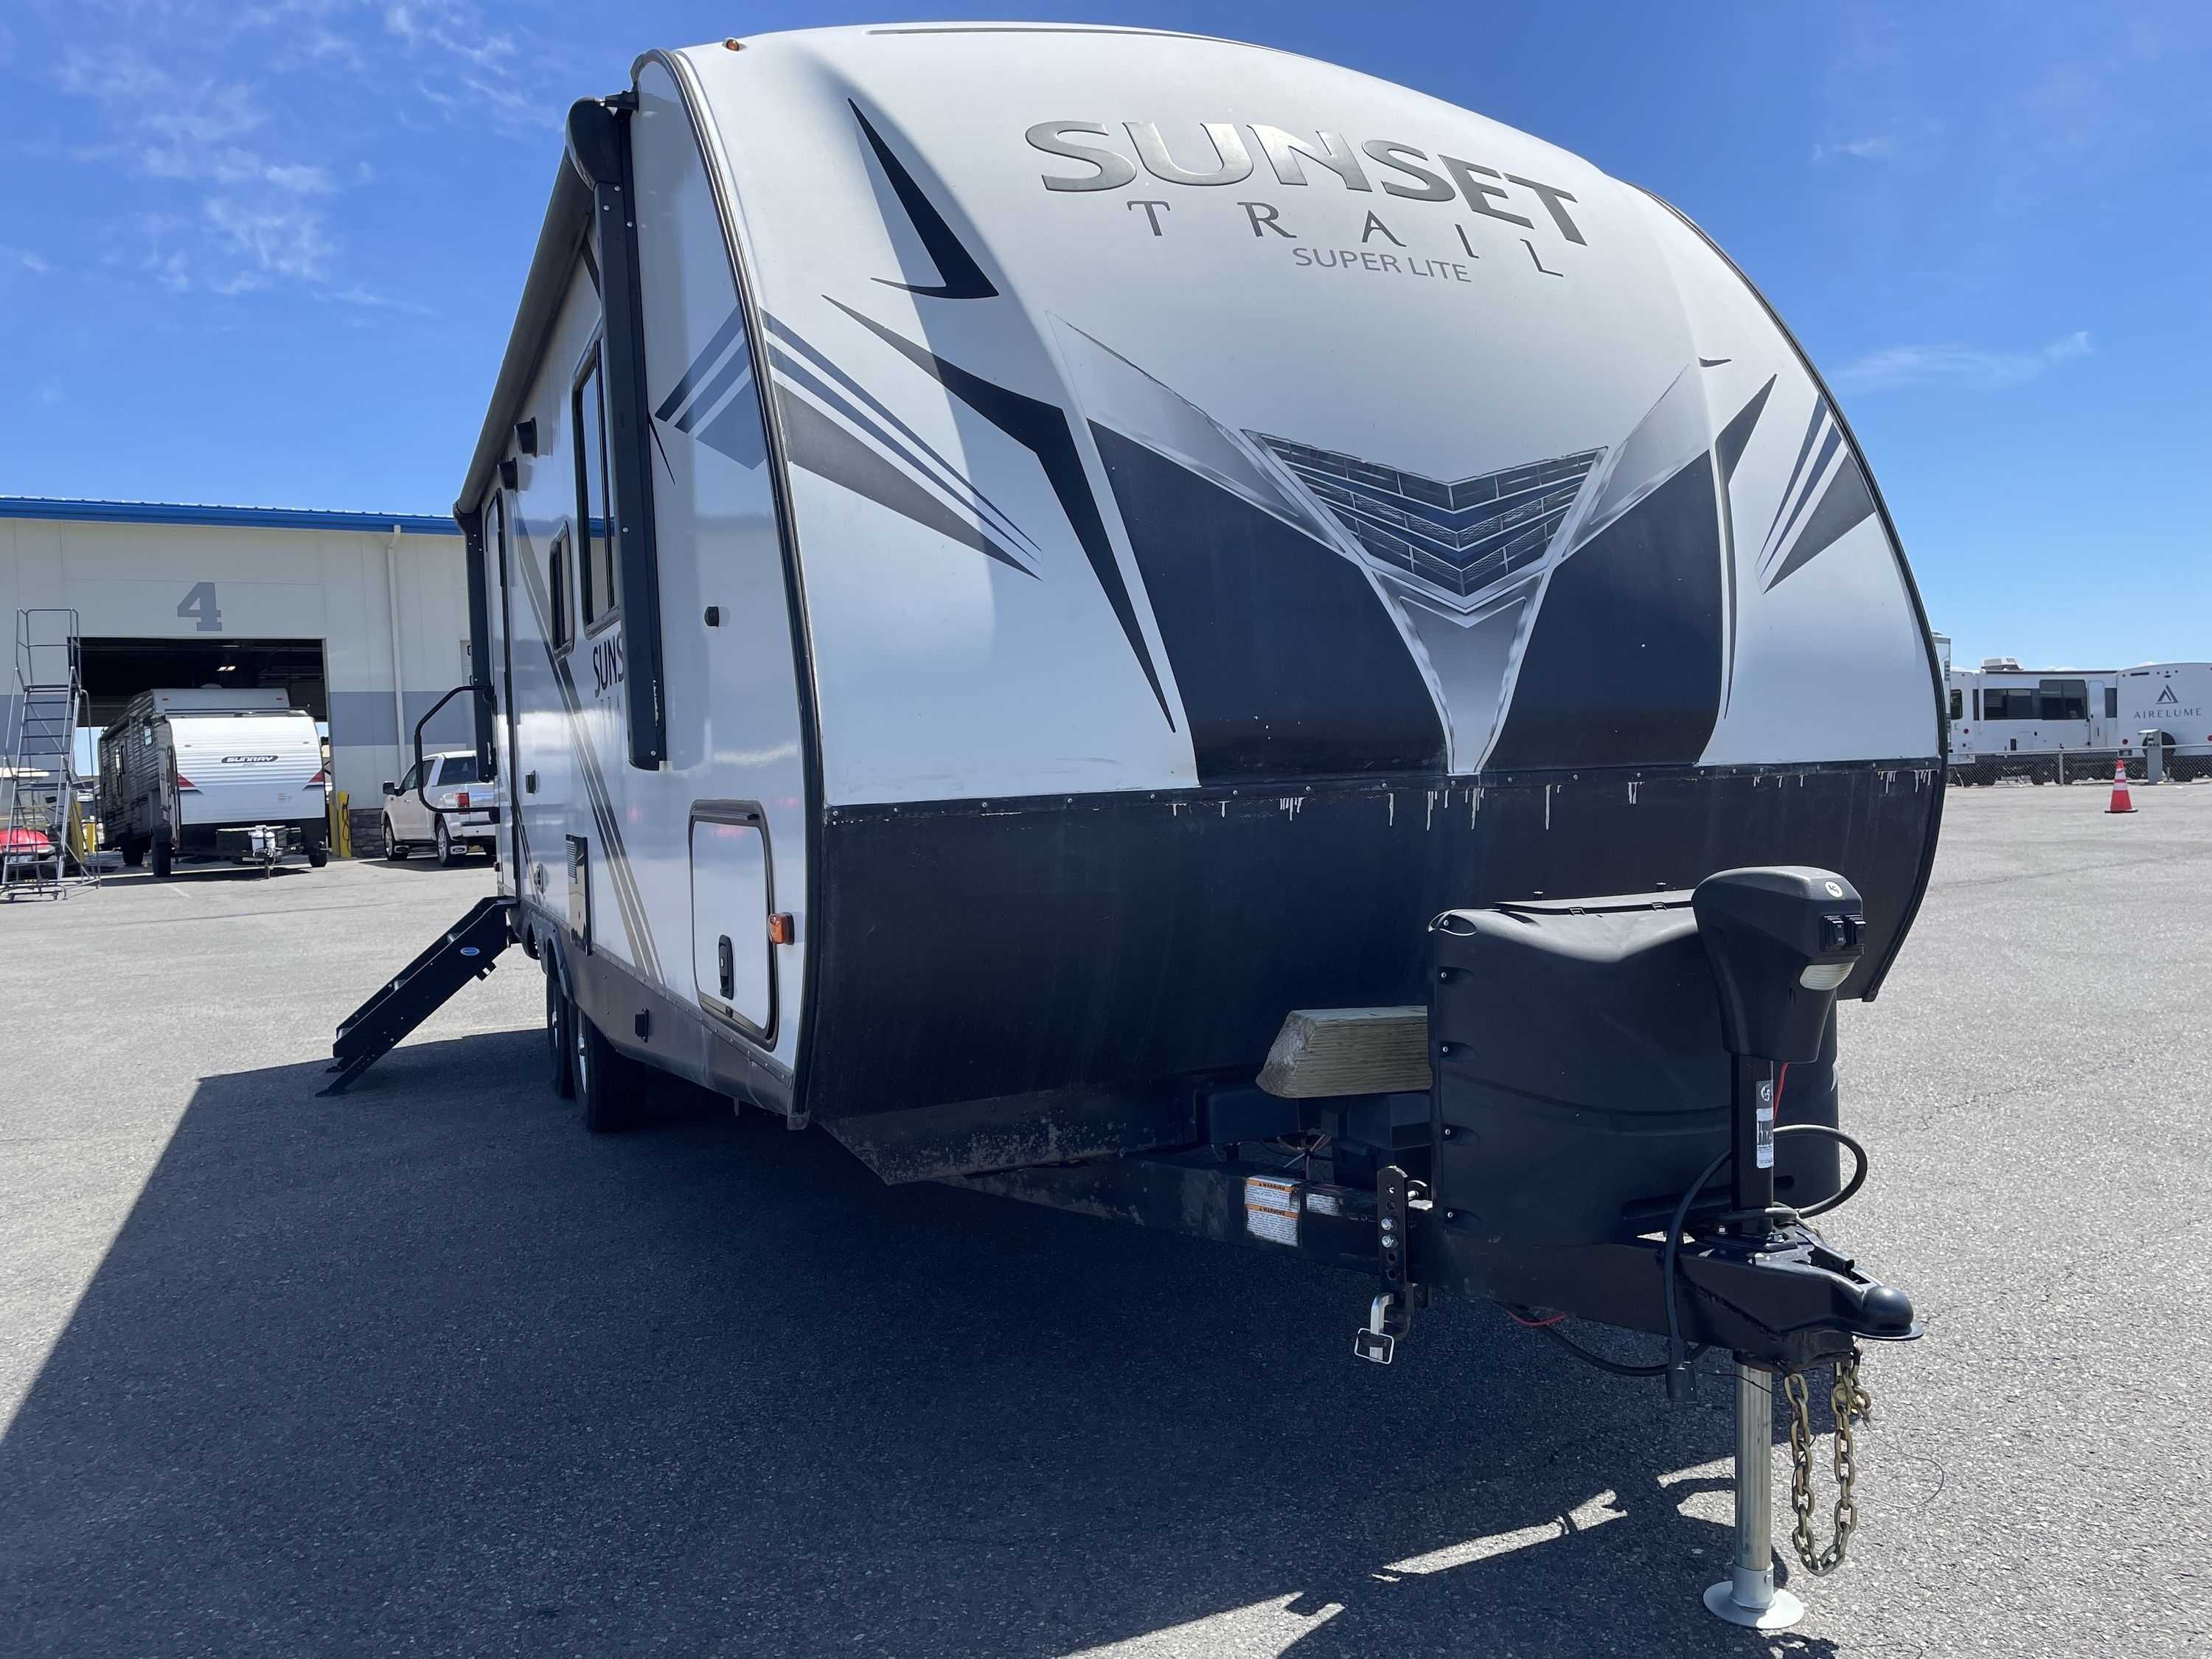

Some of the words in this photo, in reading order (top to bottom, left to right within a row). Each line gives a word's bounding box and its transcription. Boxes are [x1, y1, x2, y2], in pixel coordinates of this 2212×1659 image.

[1025, 120, 1587, 246] SUNSET
[1127, 201, 1564, 277] TRAIL
[1292, 247, 1404, 274] SUPER
[1409, 257, 1472, 283] LITE
[177, 582, 223, 632] 4
[593, 630, 625, 698] SUNS
[2134, 708, 2202, 719] AIRELUME
[1262, 1182, 1285, 1191] WARNING
[1262, 1207, 1286, 1216] WARNING
